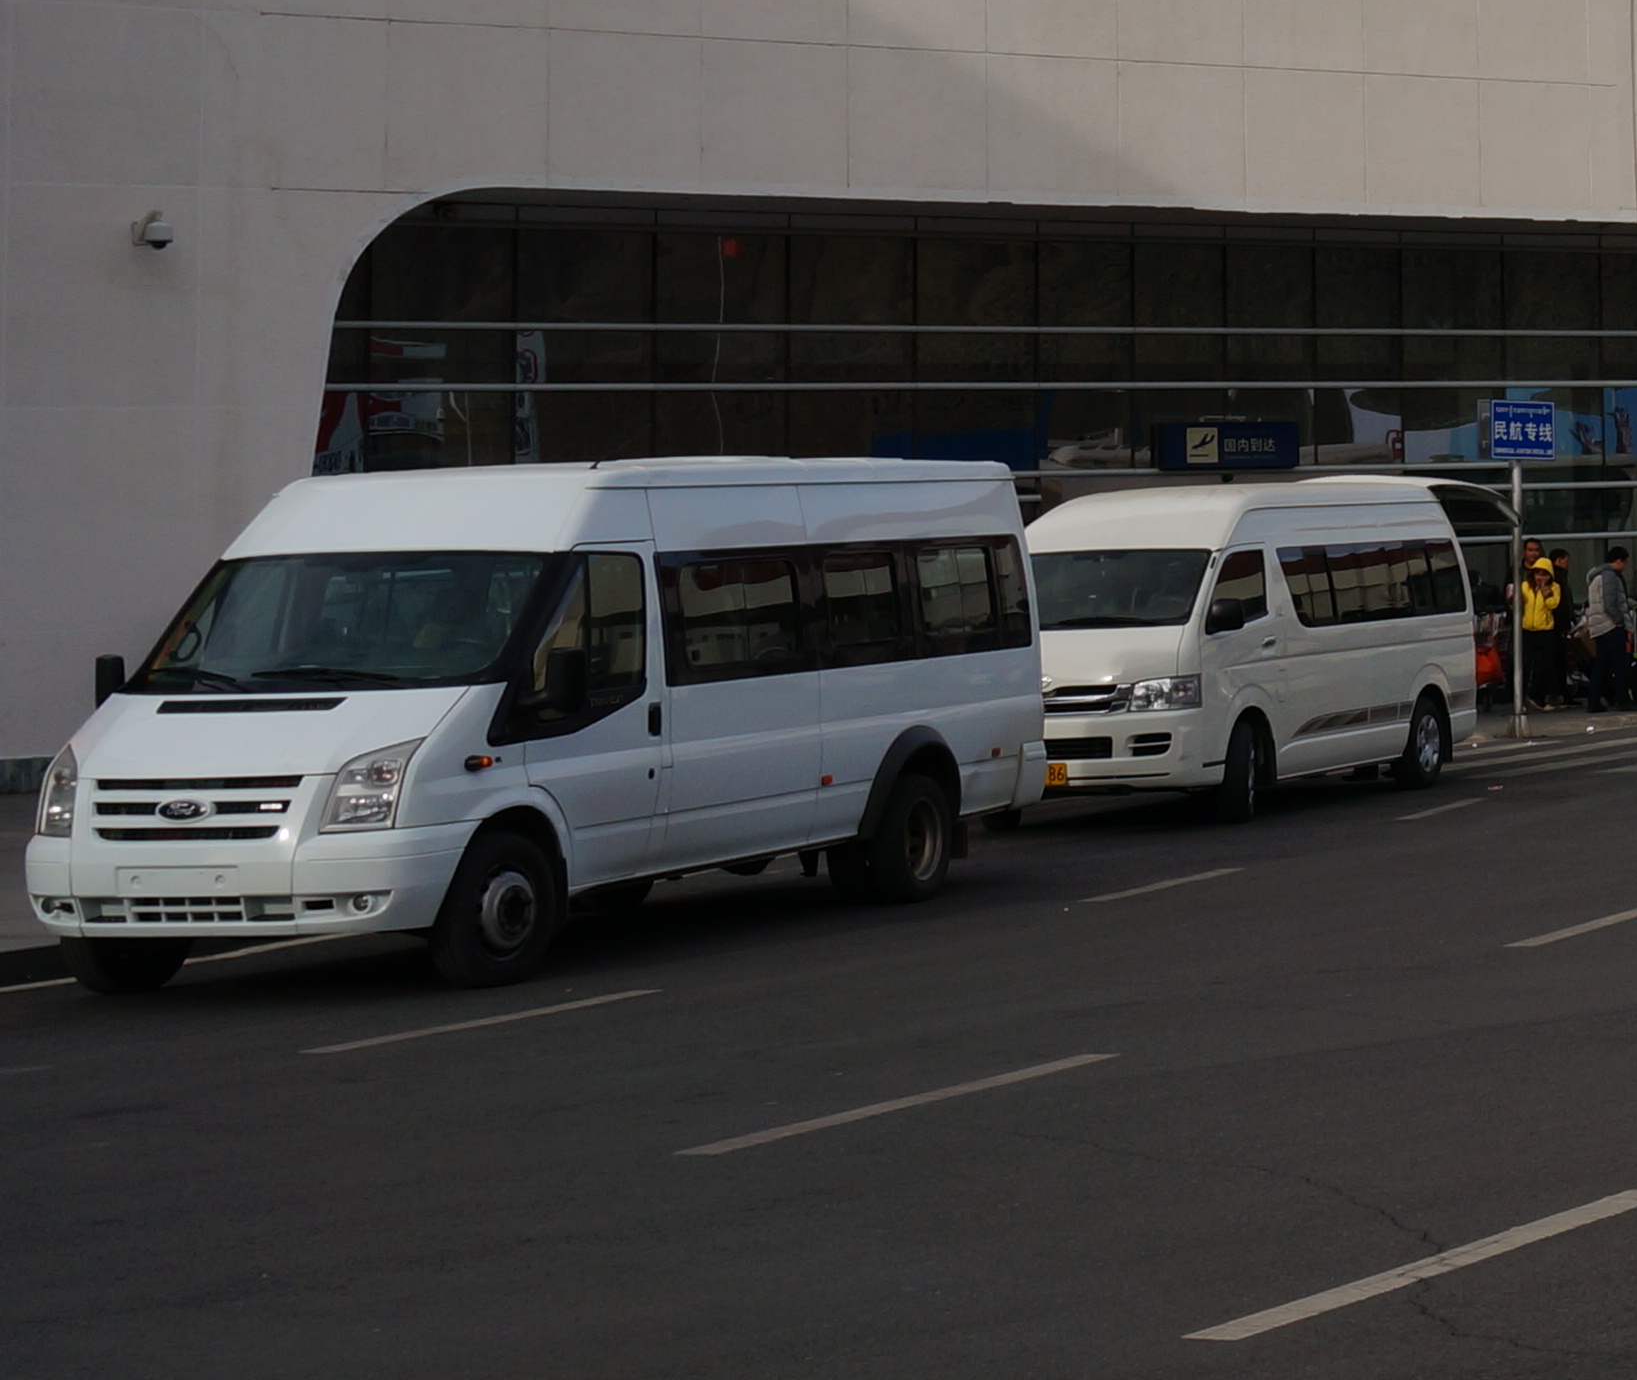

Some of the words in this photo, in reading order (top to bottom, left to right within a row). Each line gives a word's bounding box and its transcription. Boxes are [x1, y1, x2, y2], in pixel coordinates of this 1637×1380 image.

[1494, 420, 1553, 442] 民航专线
[1223, 437, 1276, 452] 国内到达
[166, 802, 196, 816] Ford
